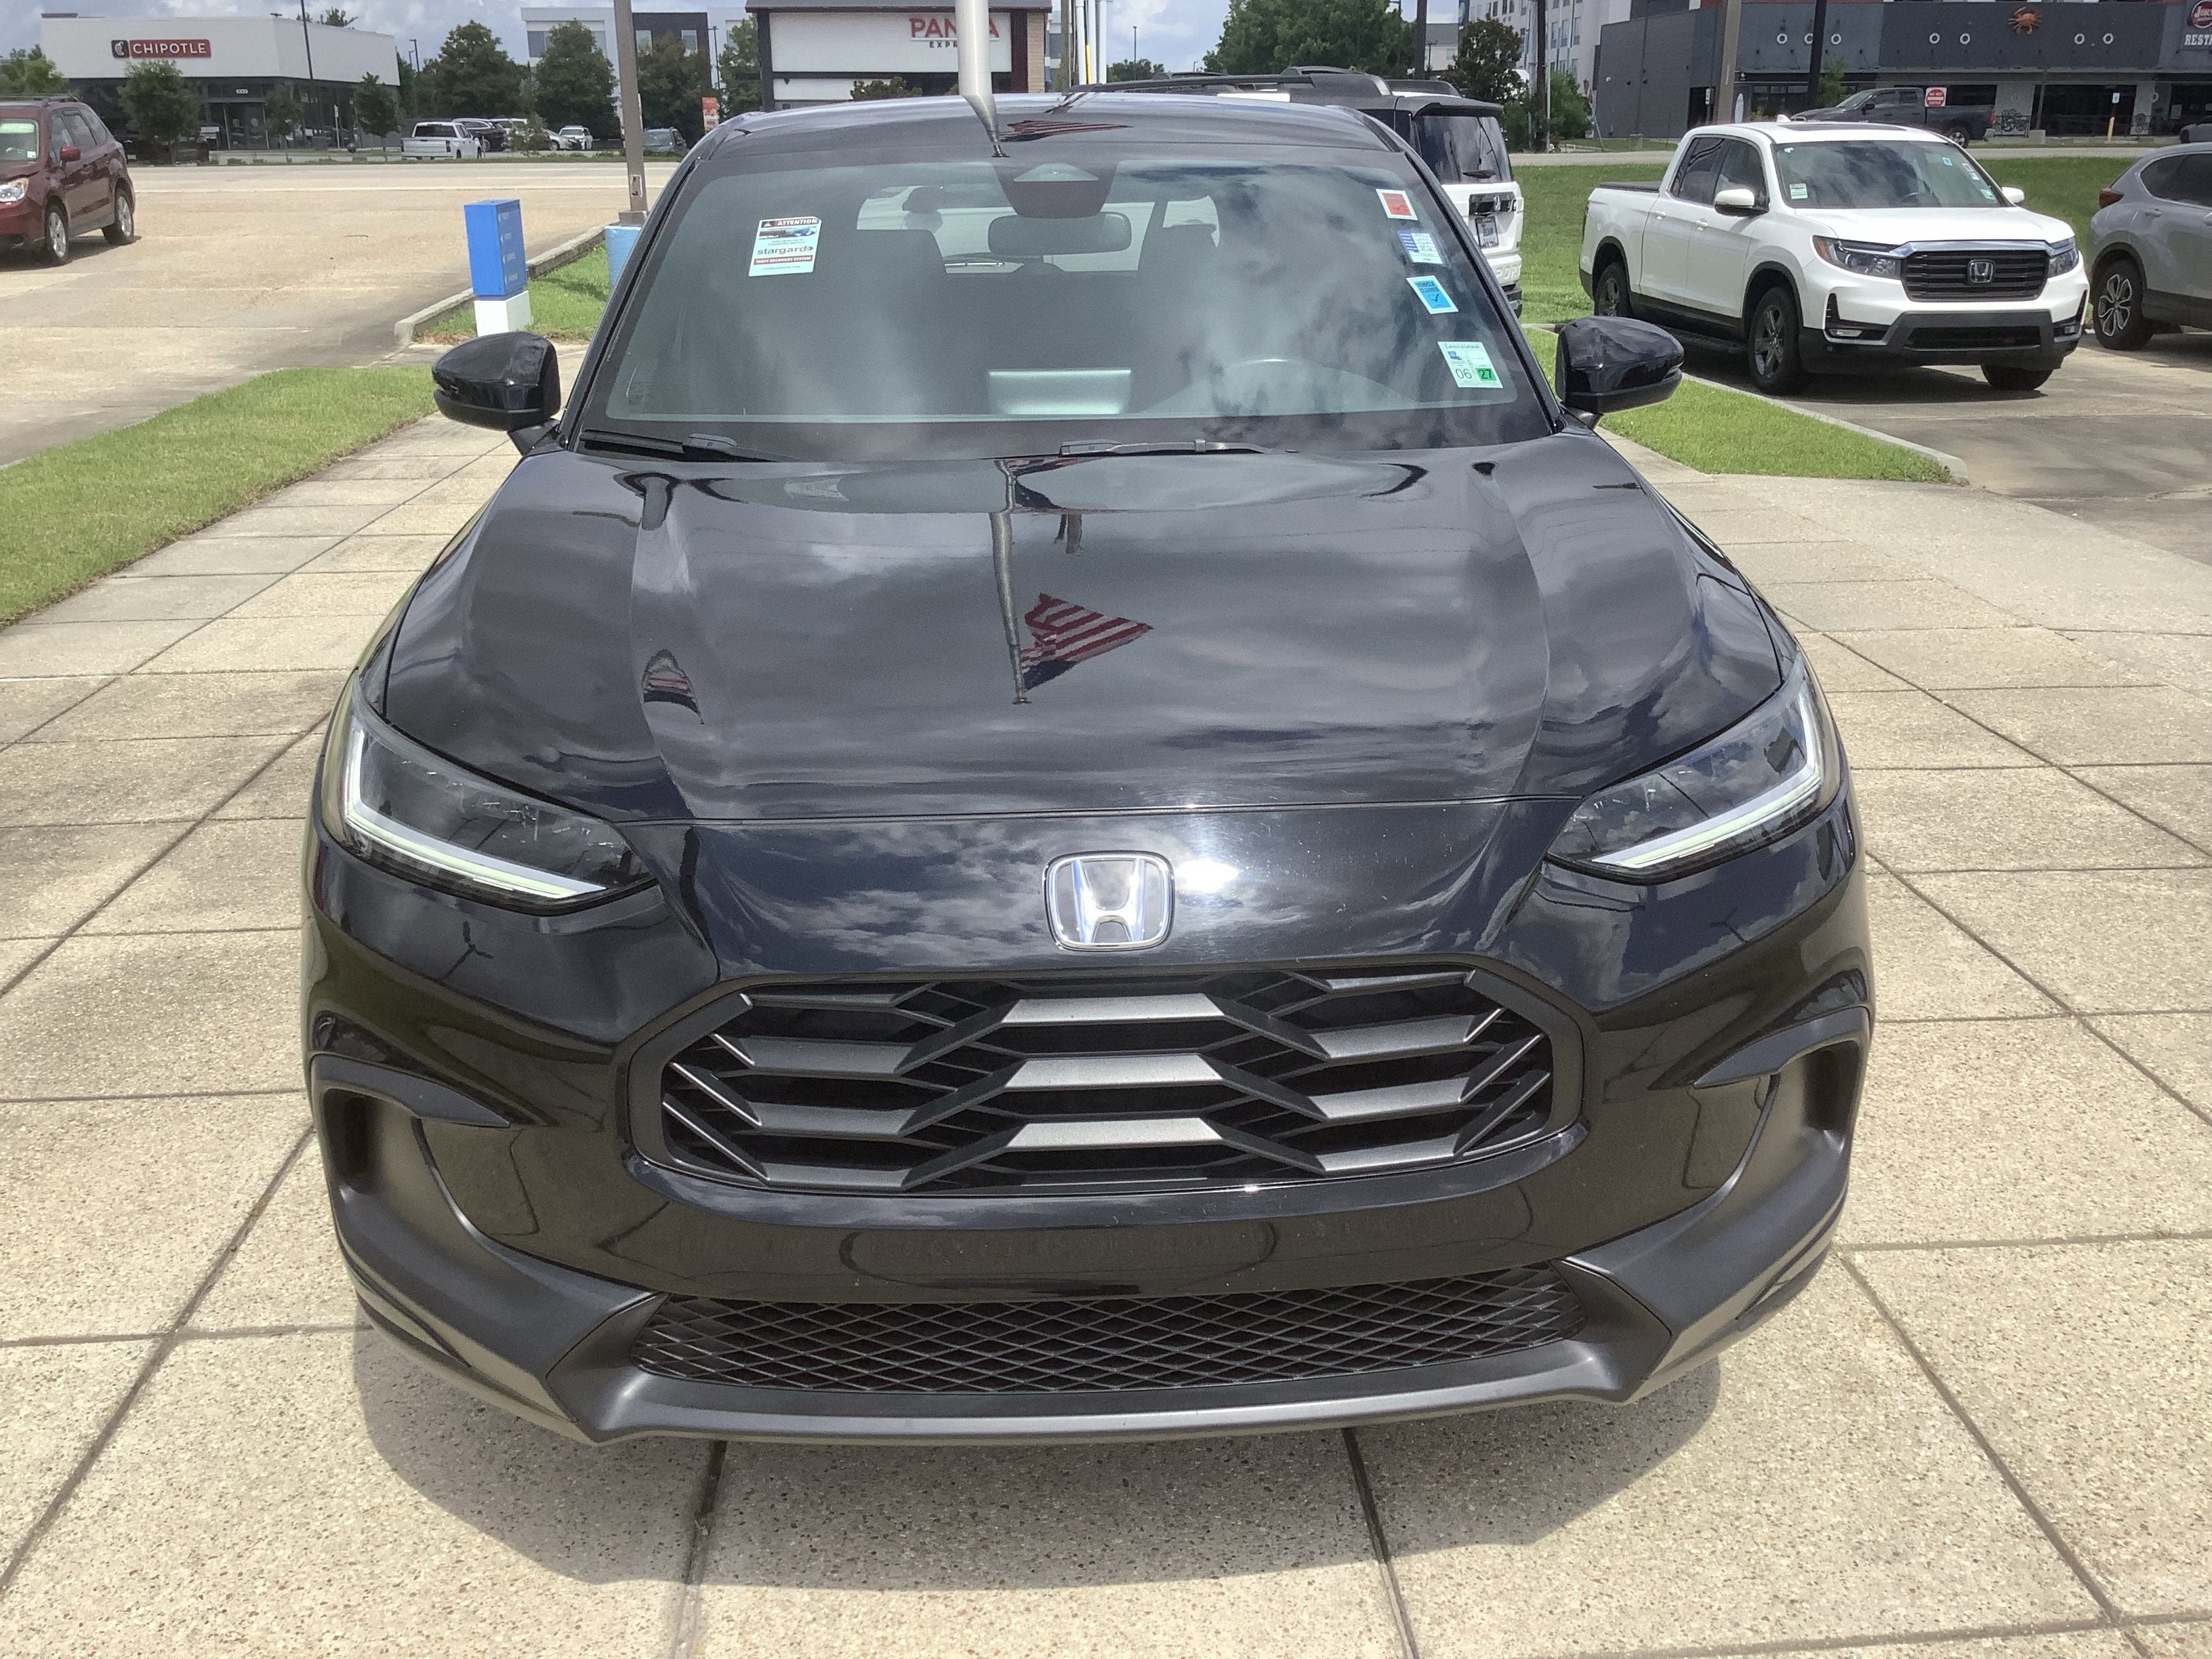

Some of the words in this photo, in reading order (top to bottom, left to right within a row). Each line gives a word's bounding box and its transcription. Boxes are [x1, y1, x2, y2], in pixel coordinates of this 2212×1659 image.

[909, 18, 1000, 38] PANA
[133, 43, 207, 54] CHIPOTLE
[777, 218, 817, 226] ATTENTION
[757, 245, 807, 255] stargard
[1455, 369, 1472, 379] 06
[1478, 369, 1492, 380] 27
